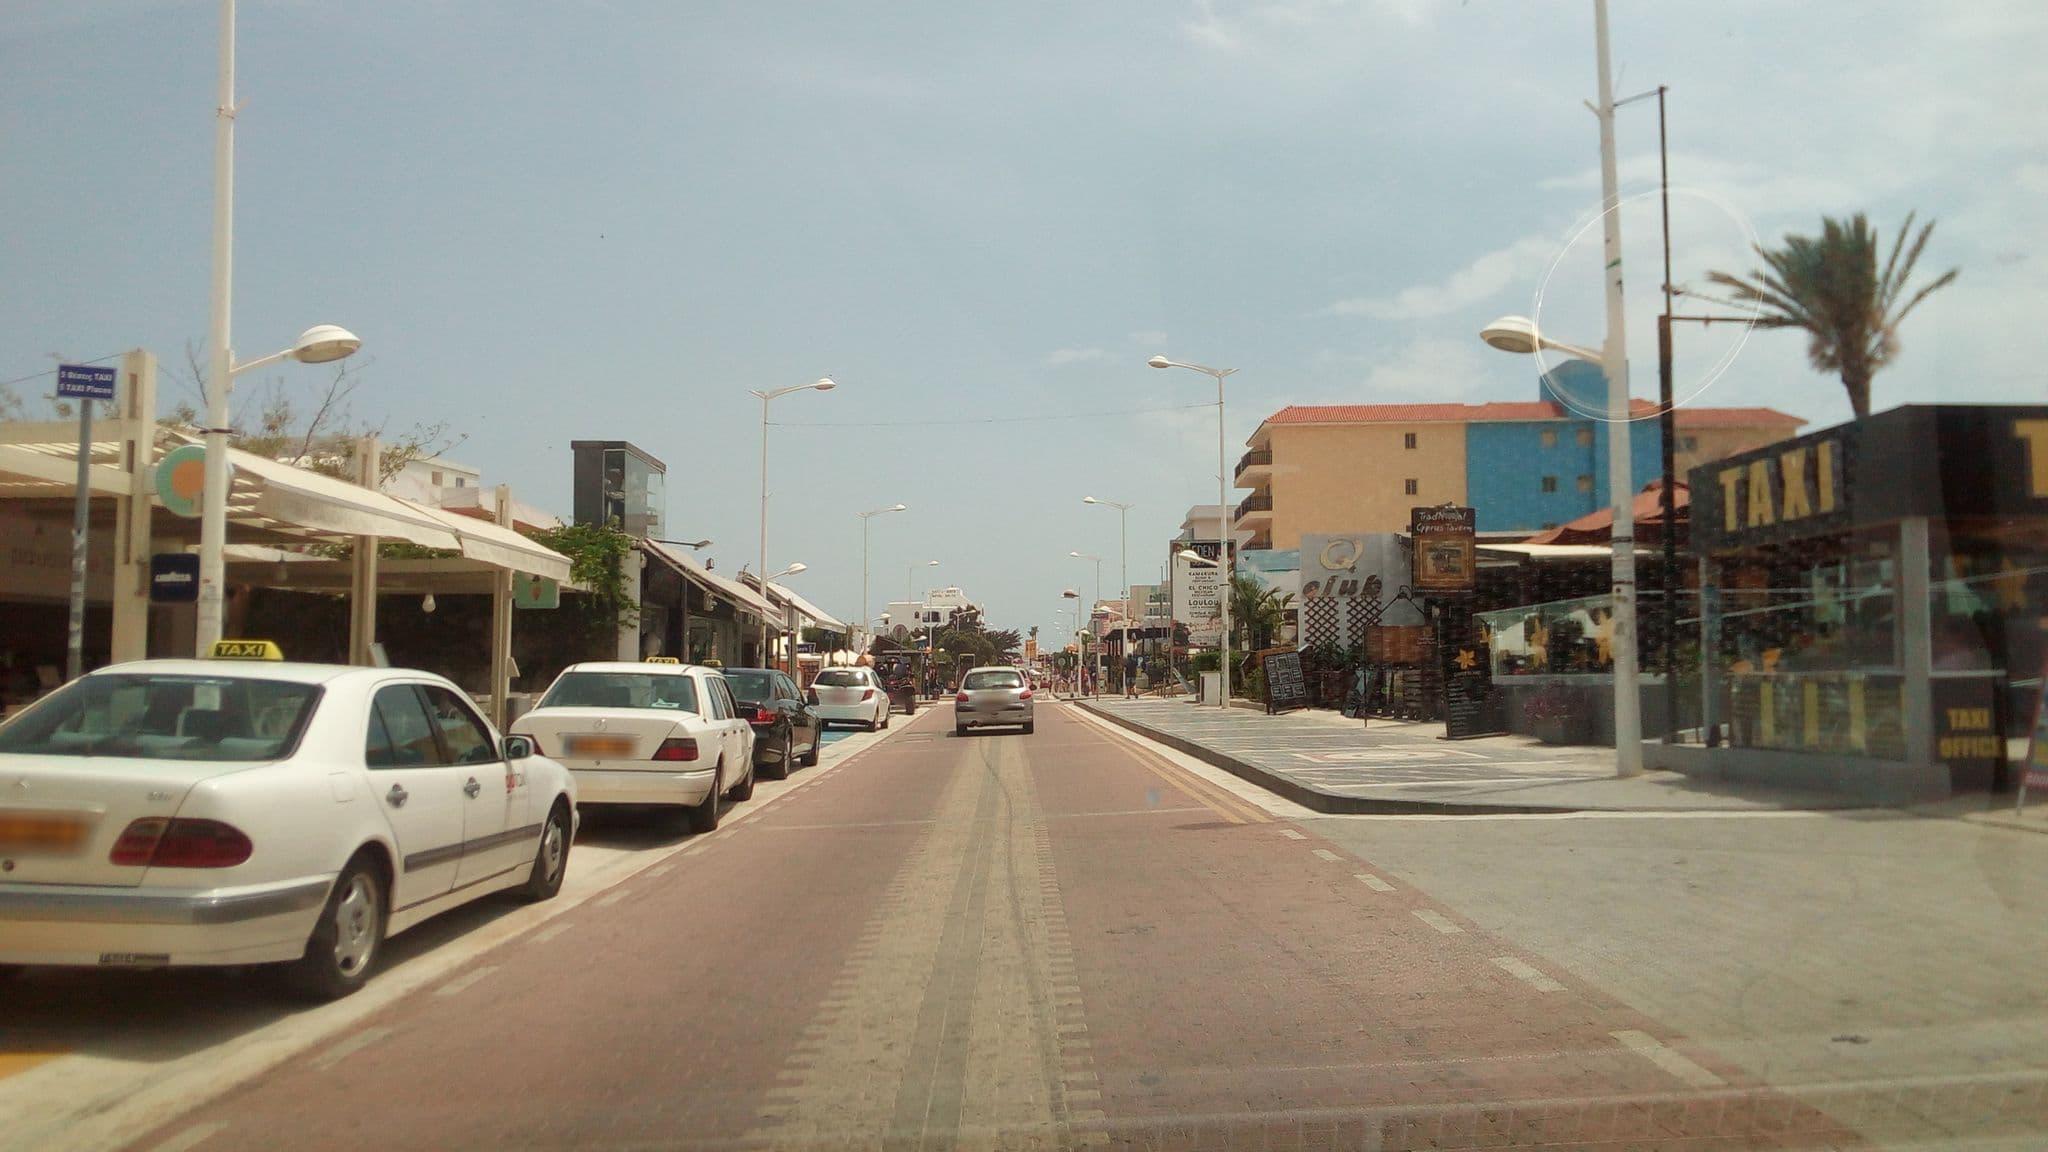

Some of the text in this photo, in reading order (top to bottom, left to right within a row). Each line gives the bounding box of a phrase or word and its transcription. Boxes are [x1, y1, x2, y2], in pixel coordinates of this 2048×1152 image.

[1719, 441, 1835, 533] TAXI
[219, 644, 264, 656] TAXI
[1946, 708, 1990, 731] TAXI
